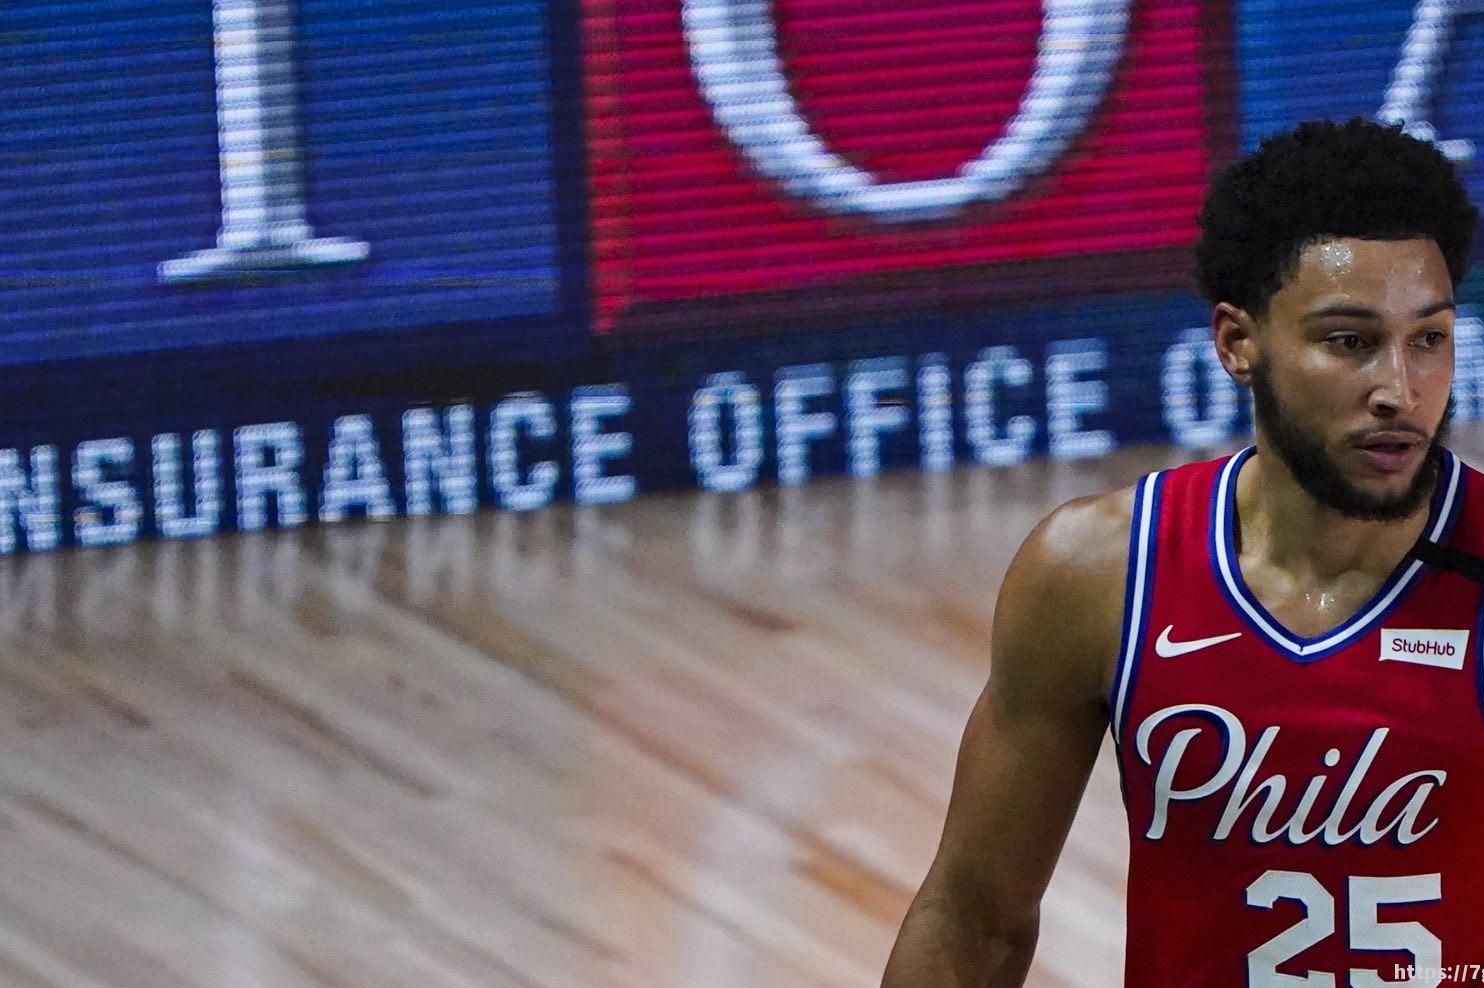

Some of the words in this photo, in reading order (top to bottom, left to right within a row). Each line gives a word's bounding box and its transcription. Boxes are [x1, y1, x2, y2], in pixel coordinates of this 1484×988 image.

[0, 384, 637, 554] NSURANCE
[688, 337, 1117, 493] OFFICE
[1161, 327, 1256, 448] O
[1391, 638, 1456, 656] StubHub
[1136, 703, 1447, 845] Phila
